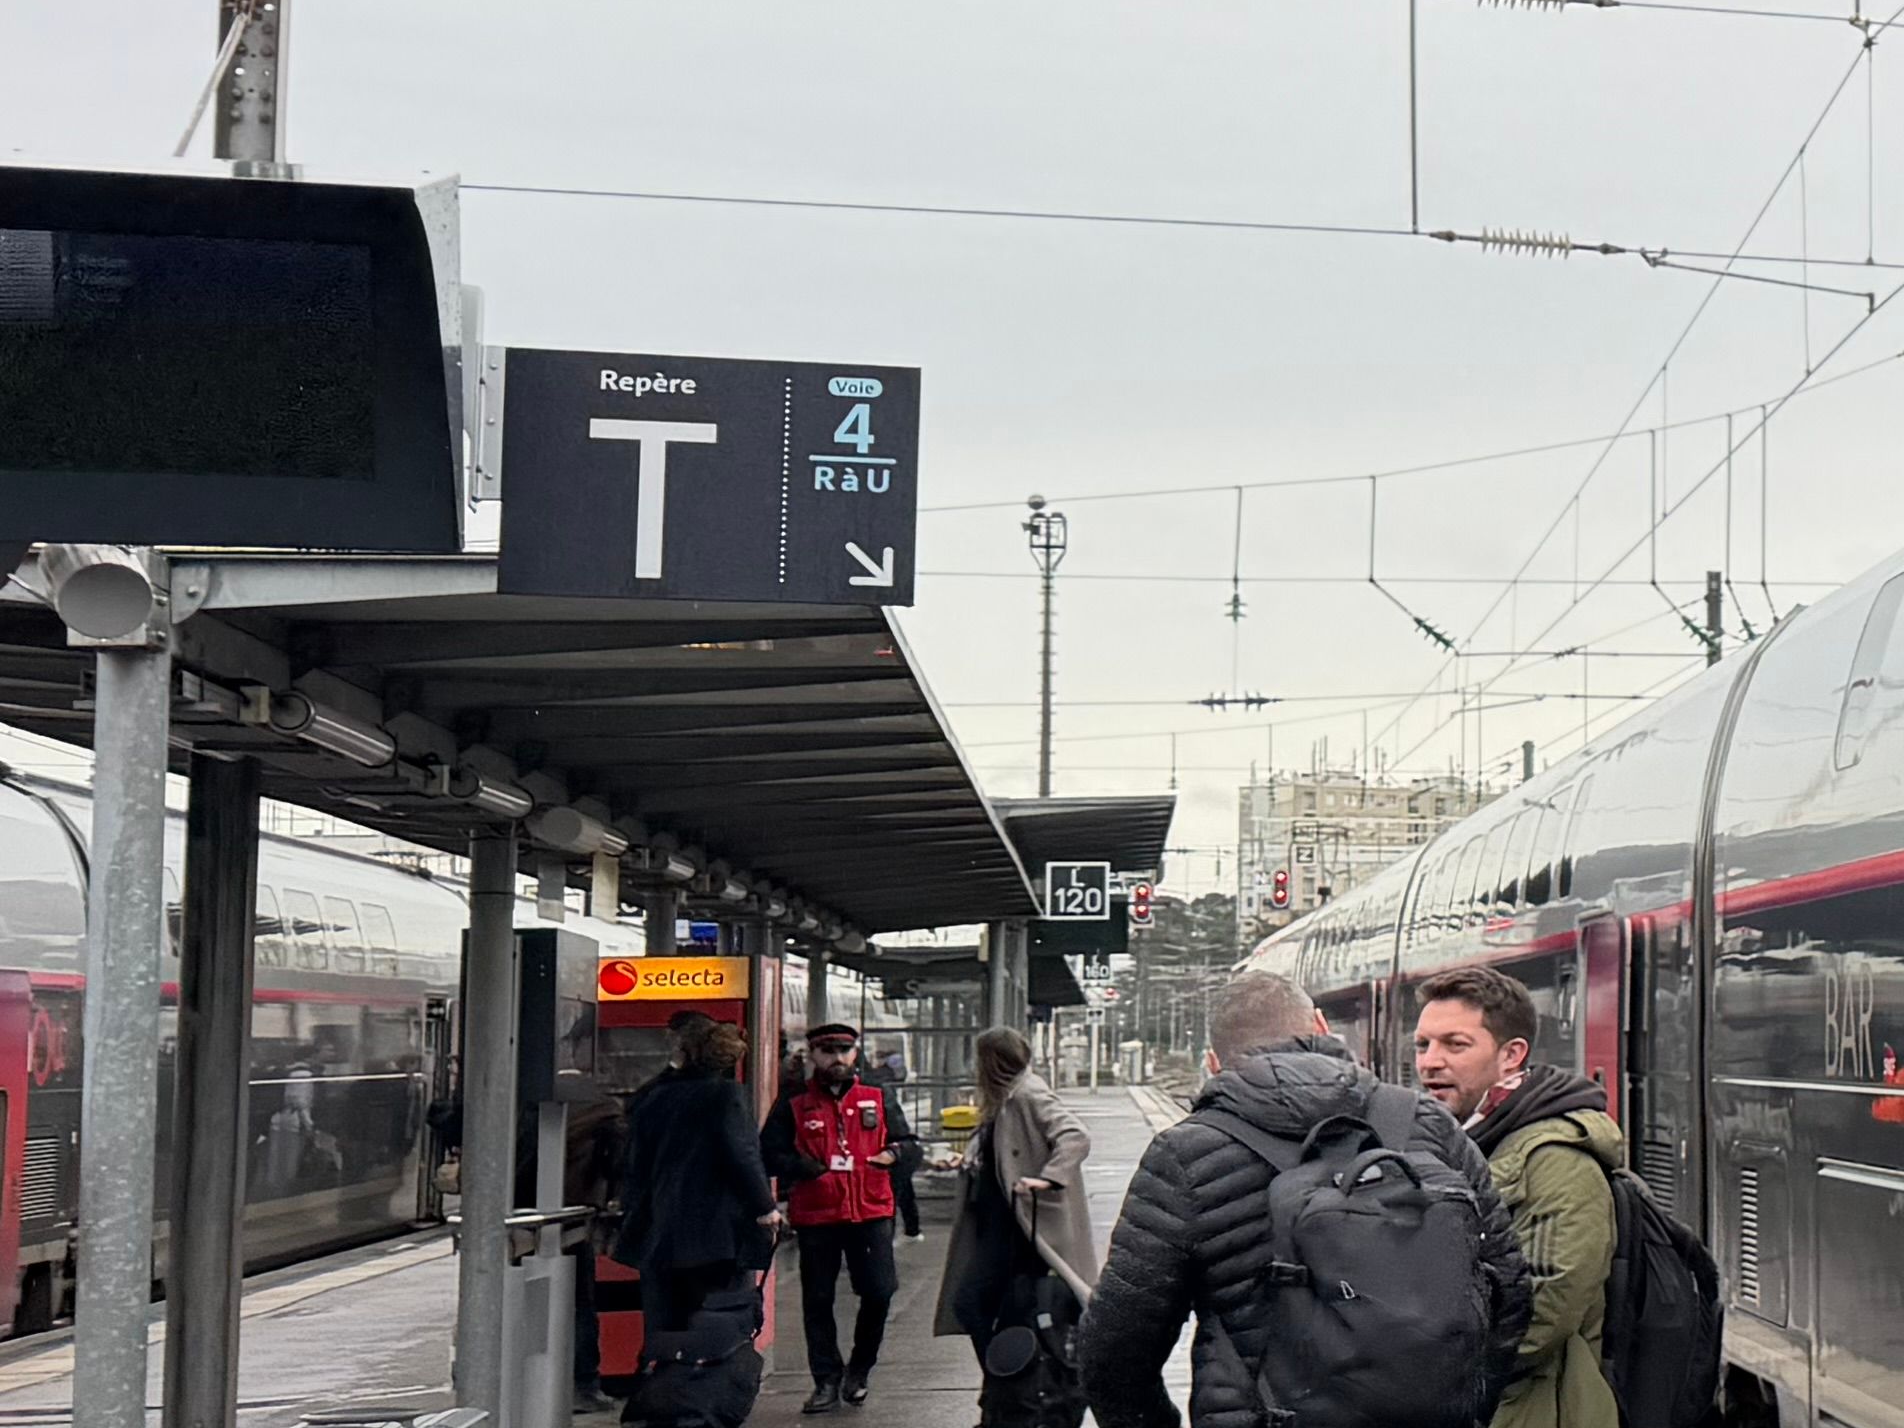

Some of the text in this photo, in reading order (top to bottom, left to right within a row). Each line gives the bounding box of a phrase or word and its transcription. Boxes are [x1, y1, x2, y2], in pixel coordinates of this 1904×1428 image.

[599, 369, 697, 397] Repère
[835, 380, 875, 395] Voie
[833, 403, 875, 454] 4
[814, 466, 890, 493] R à U
[589, 418, 717, 579] T
[1054, 888, 1102, 913] 120
[642, 969, 724, 986] selecta
[1825, 965, 1875, 1078] BAR
